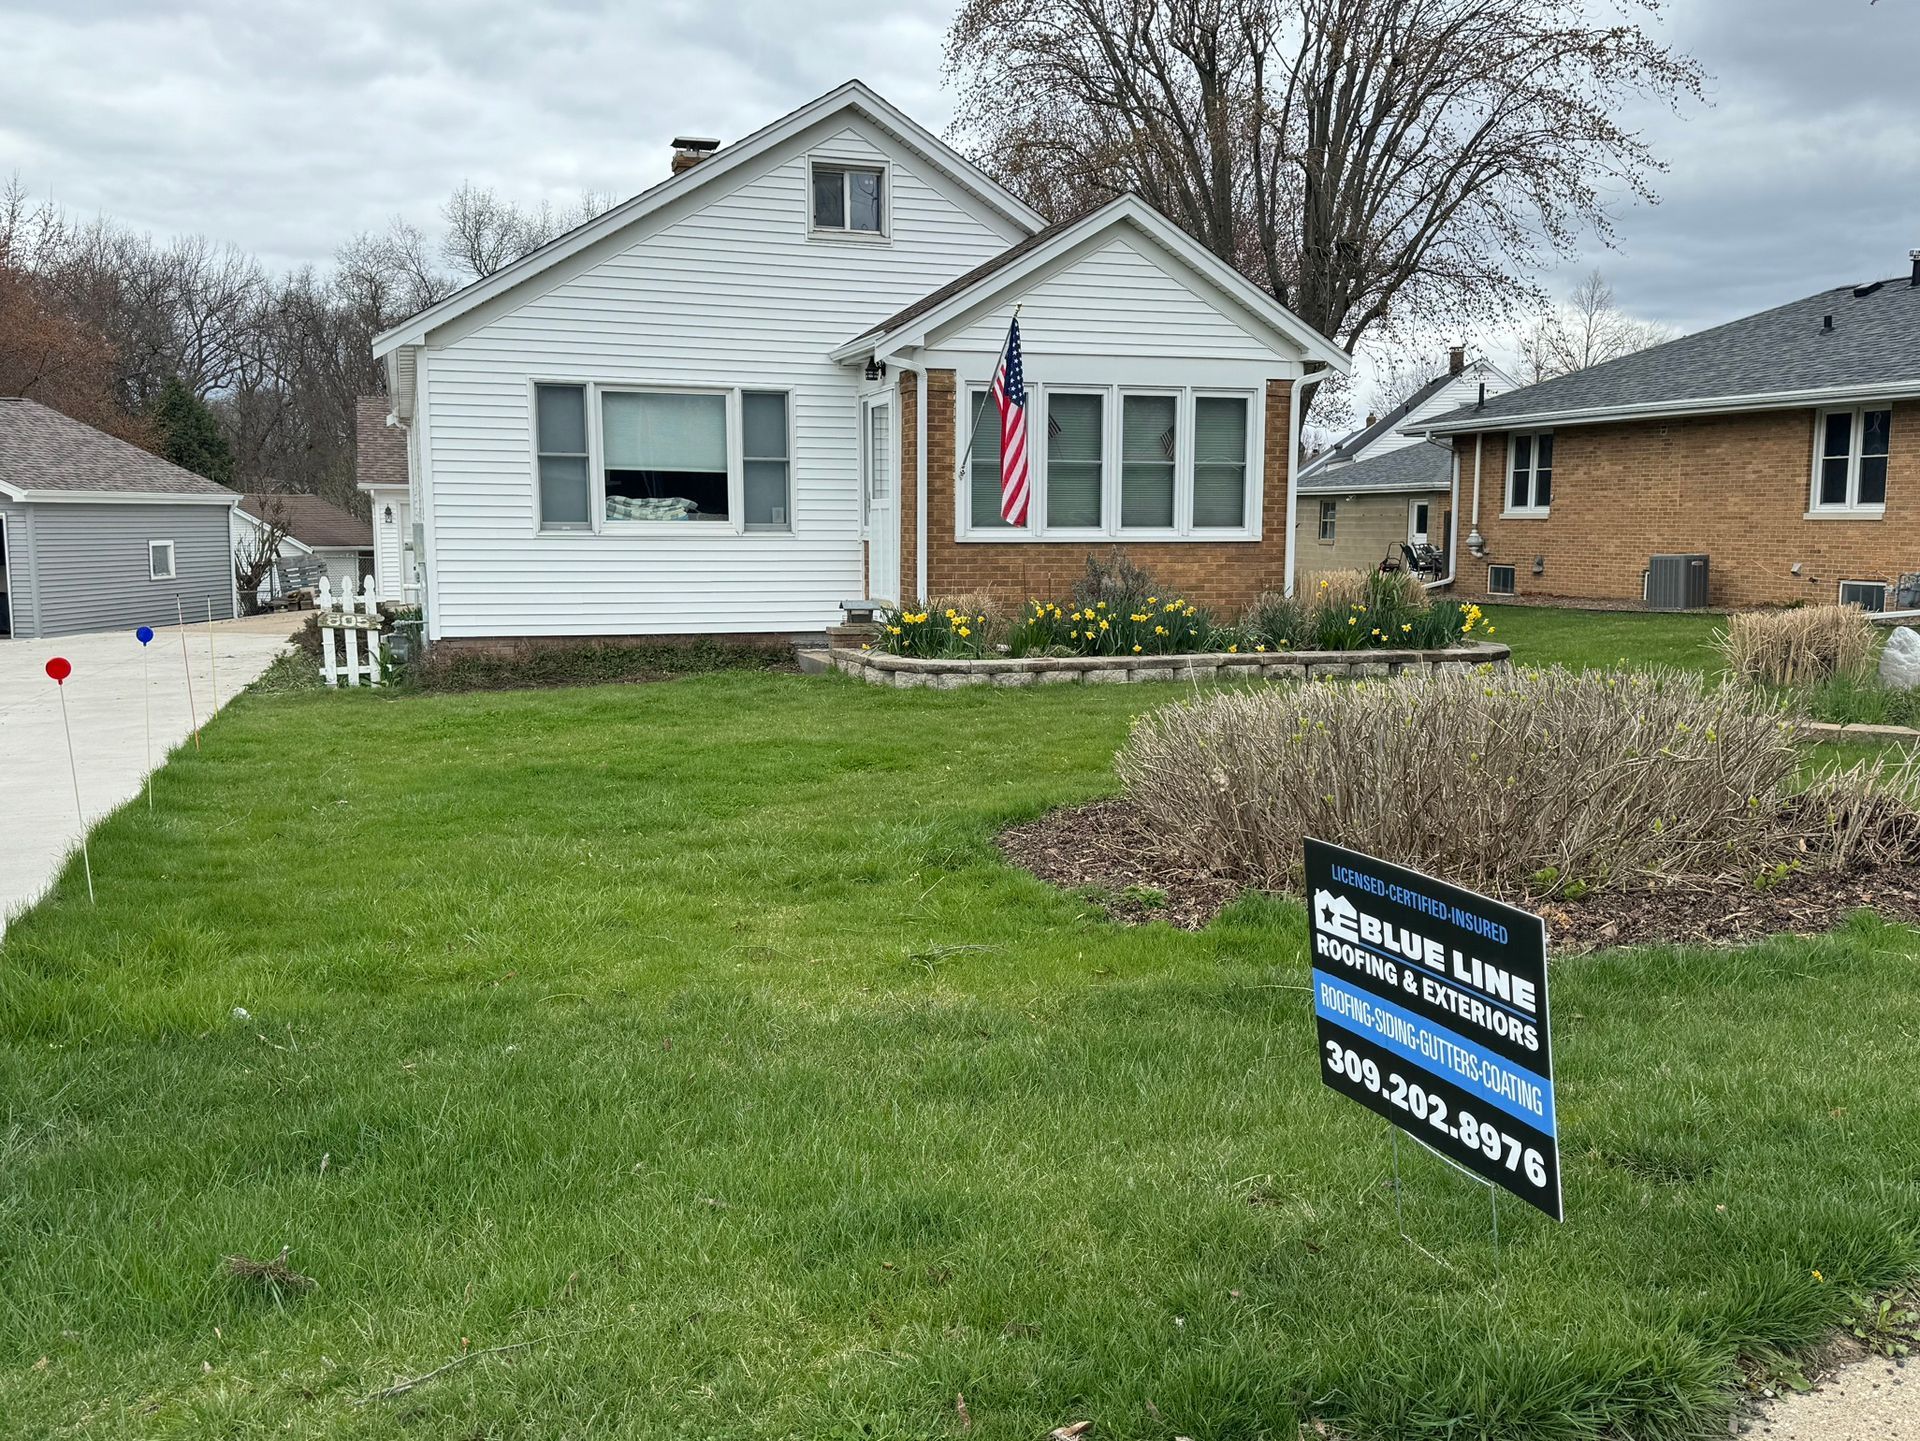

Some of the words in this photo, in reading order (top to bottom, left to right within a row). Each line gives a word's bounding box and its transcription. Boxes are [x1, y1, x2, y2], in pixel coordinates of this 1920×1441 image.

[1316, 933, 1399, 986] ROOFING
[1403, 969, 1418, 996] &
[1422, 976, 1539, 1052] EXTERIORS
[1360, 912, 1446, 972] BLUE
[1452, 950, 1536, 1013] LINE
[1325, 1040, 1547, 1188] 309.202.8976
